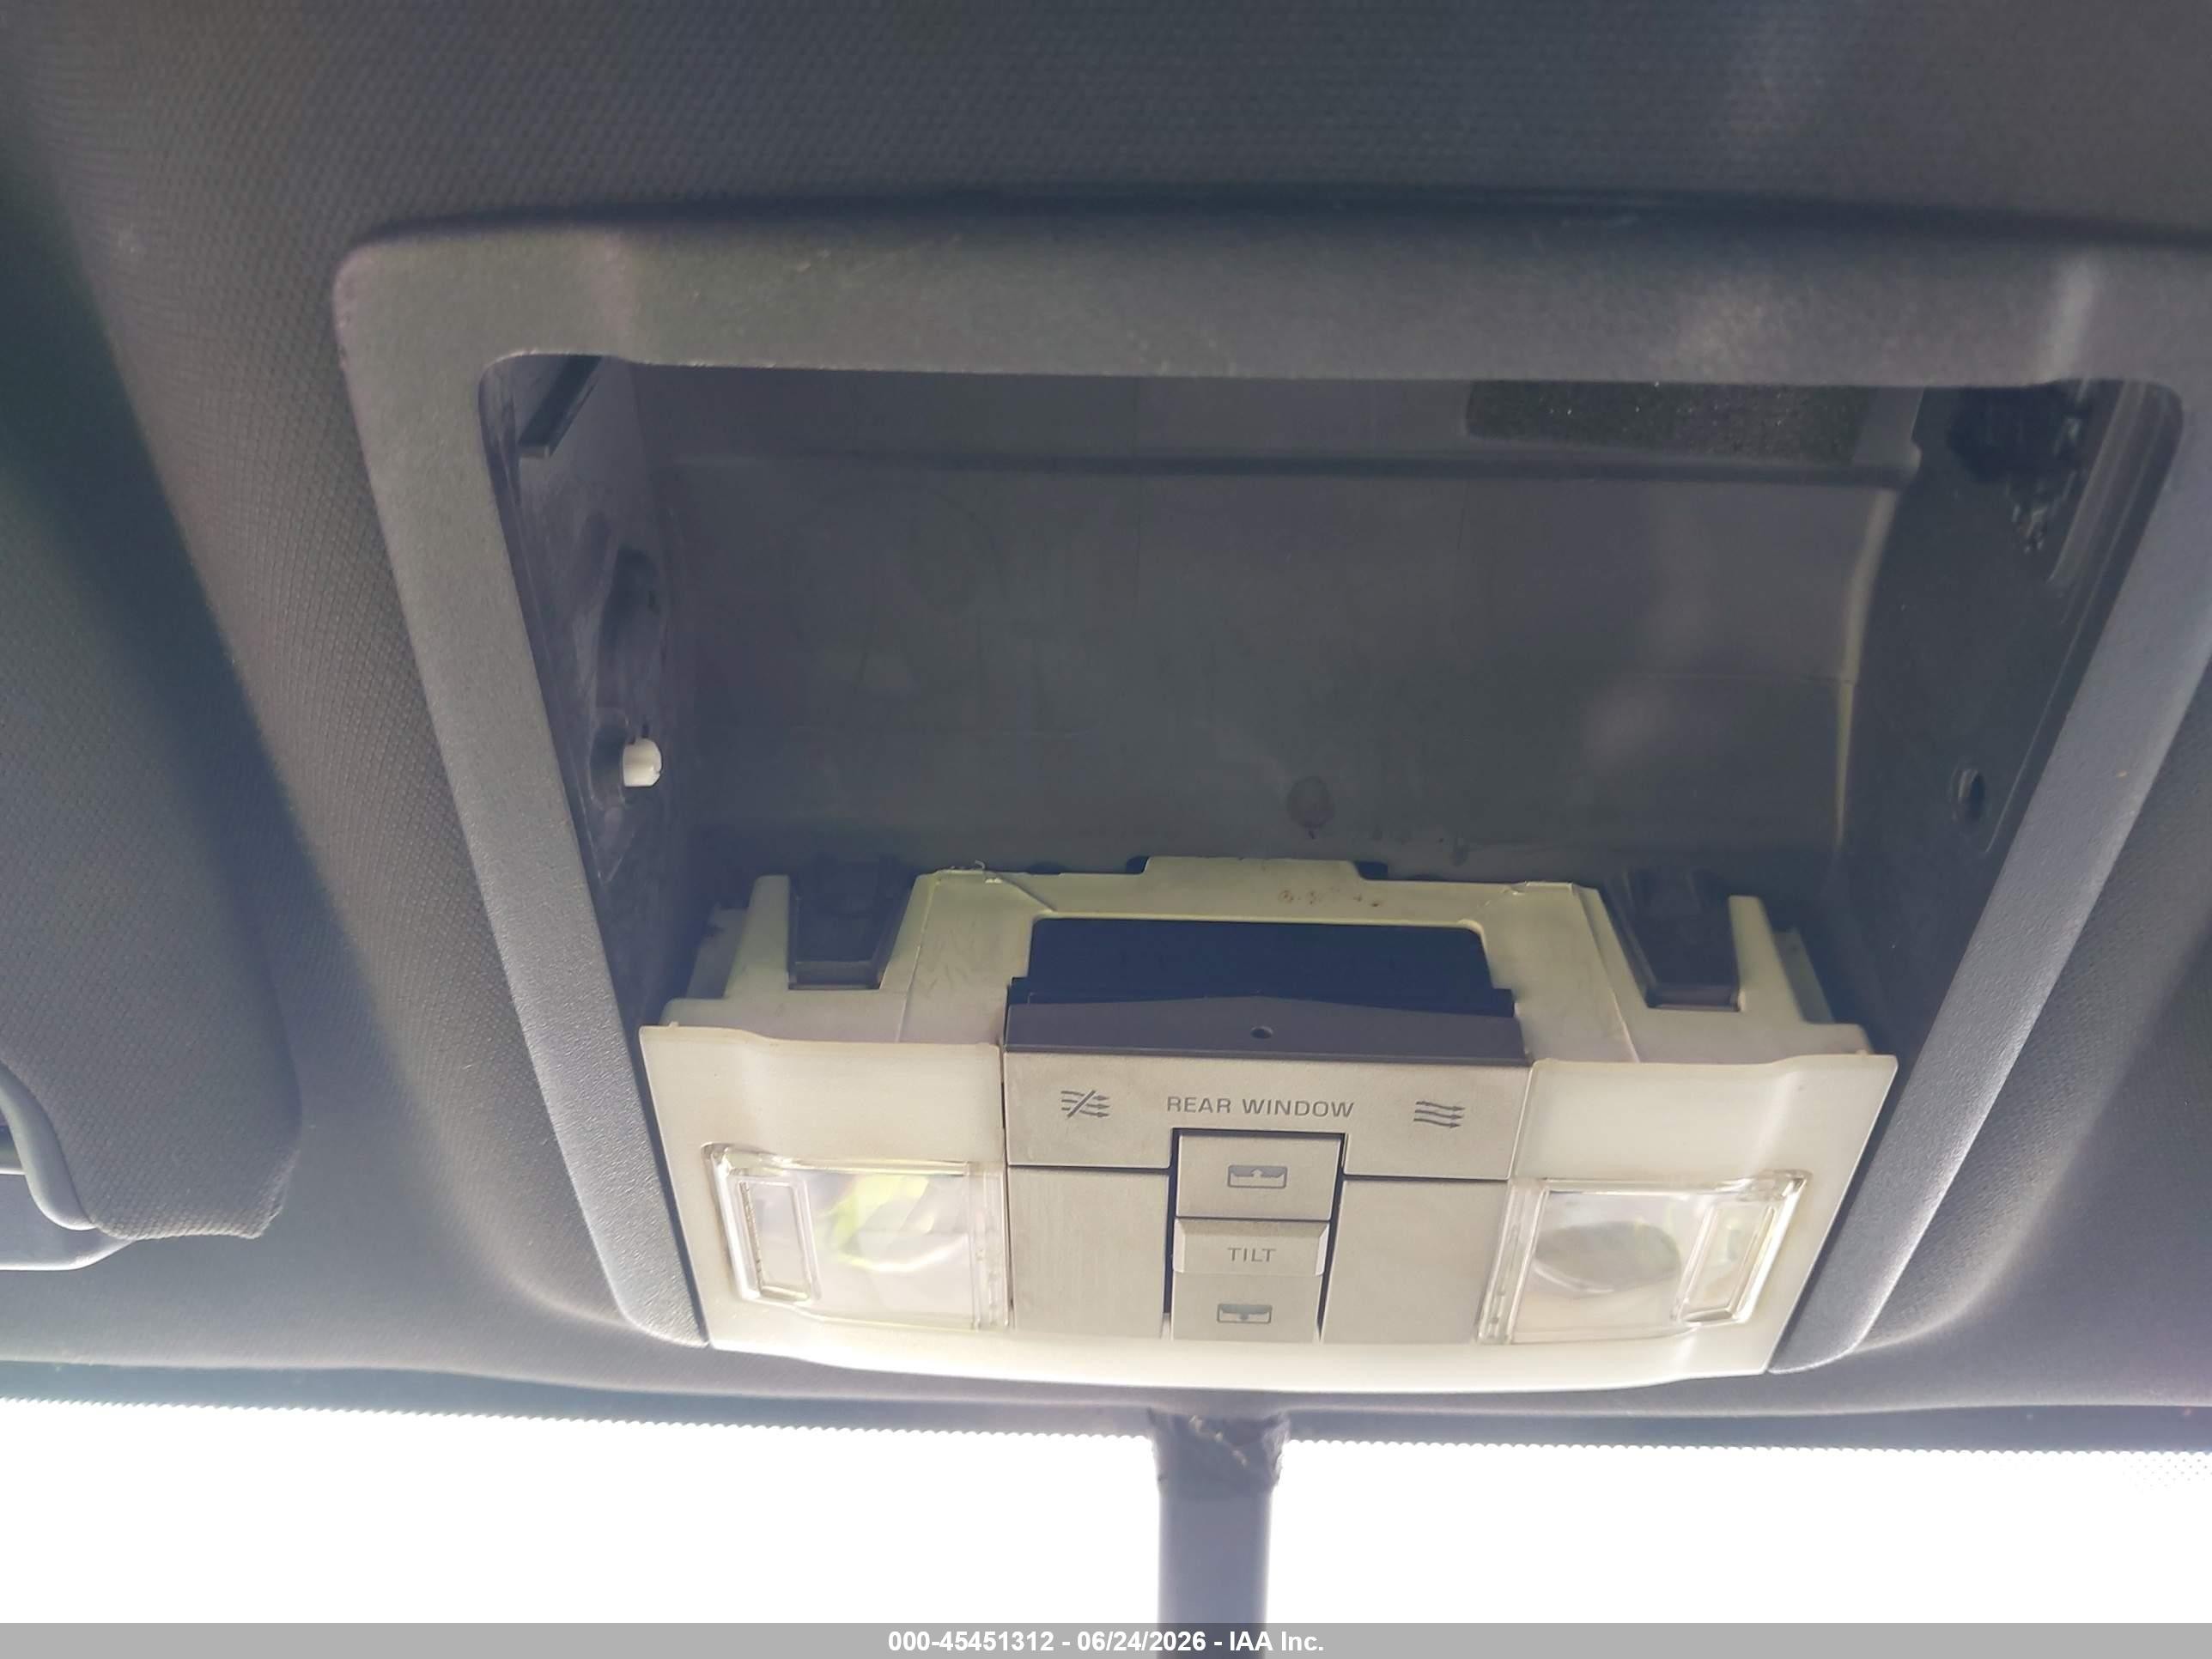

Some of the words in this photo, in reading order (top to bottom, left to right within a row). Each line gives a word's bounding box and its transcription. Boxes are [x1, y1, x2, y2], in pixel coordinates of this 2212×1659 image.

[1167, 1097, 1231, 1114] REAR
[1242, 1098, 1354, 1118] WINDOW
[1228, 1248, 1276, 1263] TILT
